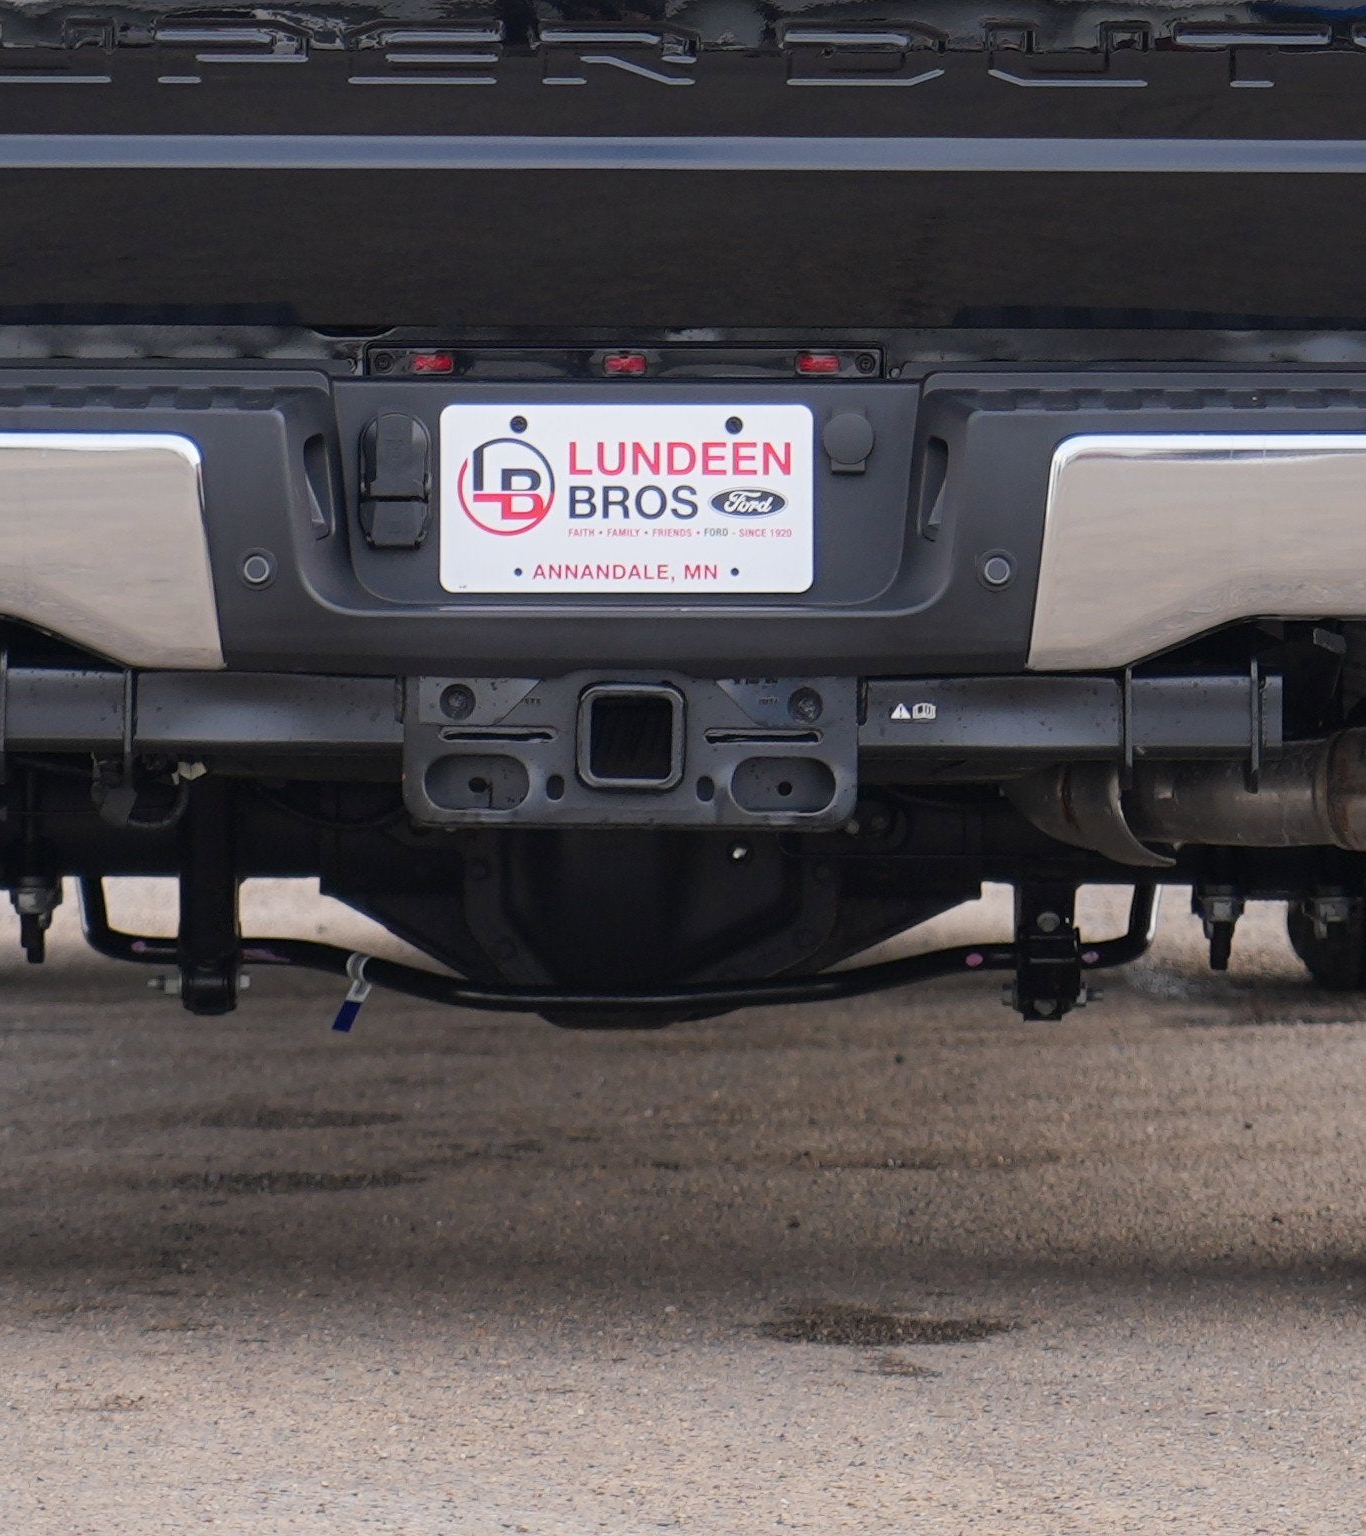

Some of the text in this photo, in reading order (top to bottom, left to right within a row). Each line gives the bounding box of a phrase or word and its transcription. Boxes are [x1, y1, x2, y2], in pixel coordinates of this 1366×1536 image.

[568, 441, 792, 476] LUNDEEN
[568, 484, 773, 520] BROS Ford
[568, 528, 793, 538] FAITH FAMILY FRIENDS FORD SINCE 1920
[533, 564, 718, 582] ANNANDALE, MN
